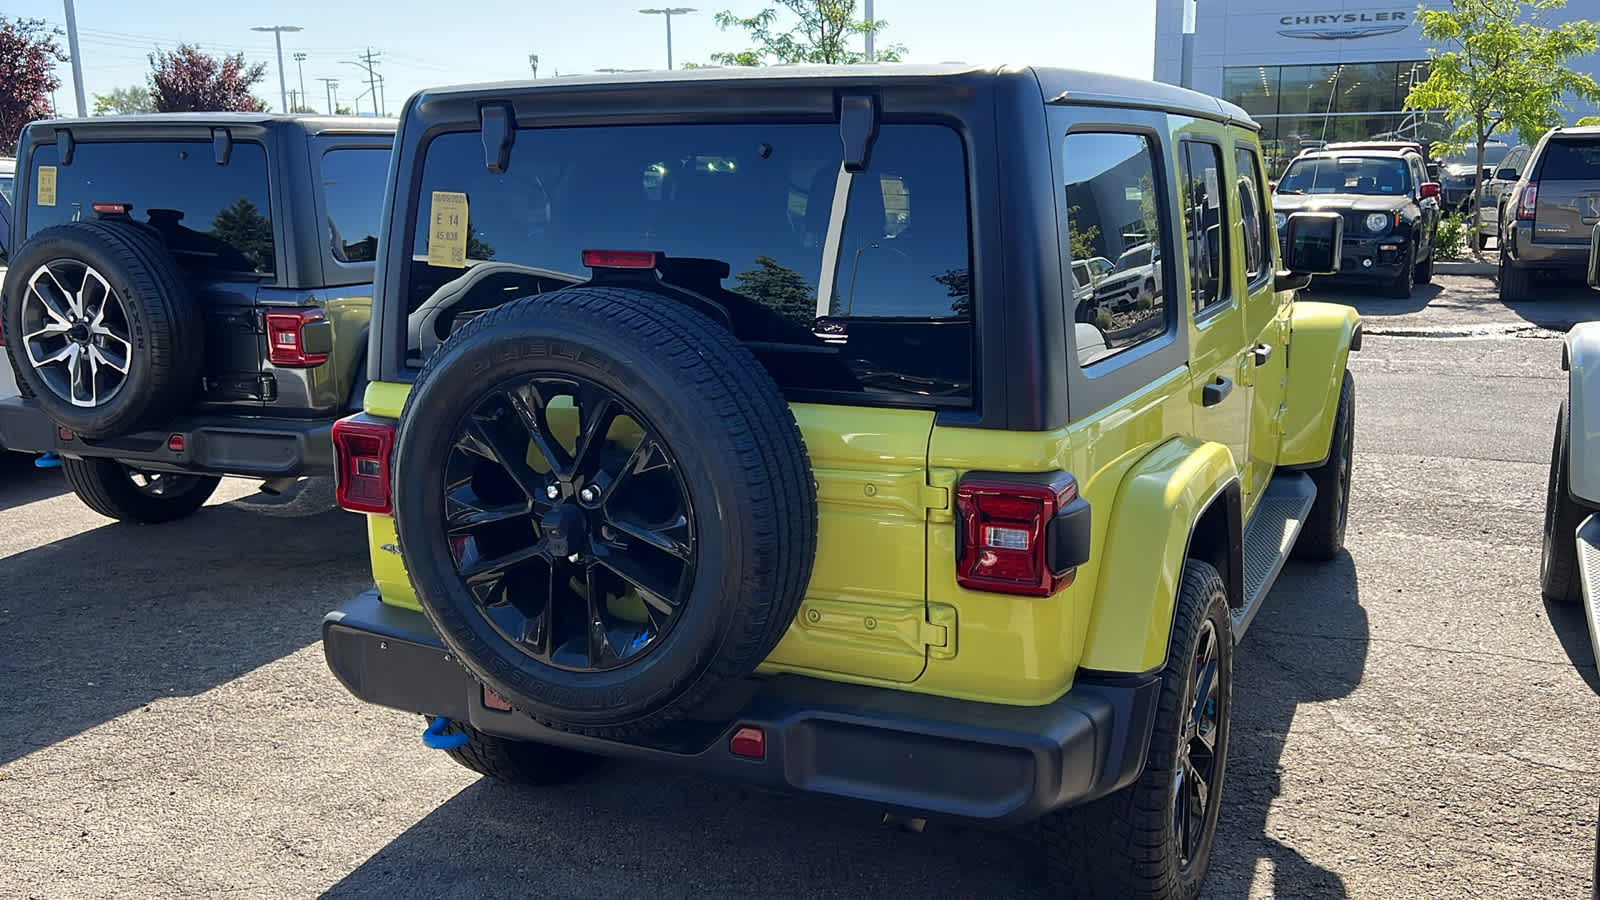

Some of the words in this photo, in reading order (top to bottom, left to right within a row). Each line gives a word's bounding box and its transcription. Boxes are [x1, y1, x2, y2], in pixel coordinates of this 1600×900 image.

[1279, 11, 1406, 25] CHRYSLER
[436, 213, 442, 225] E
[122, 287, 145, 349] NEXEN
